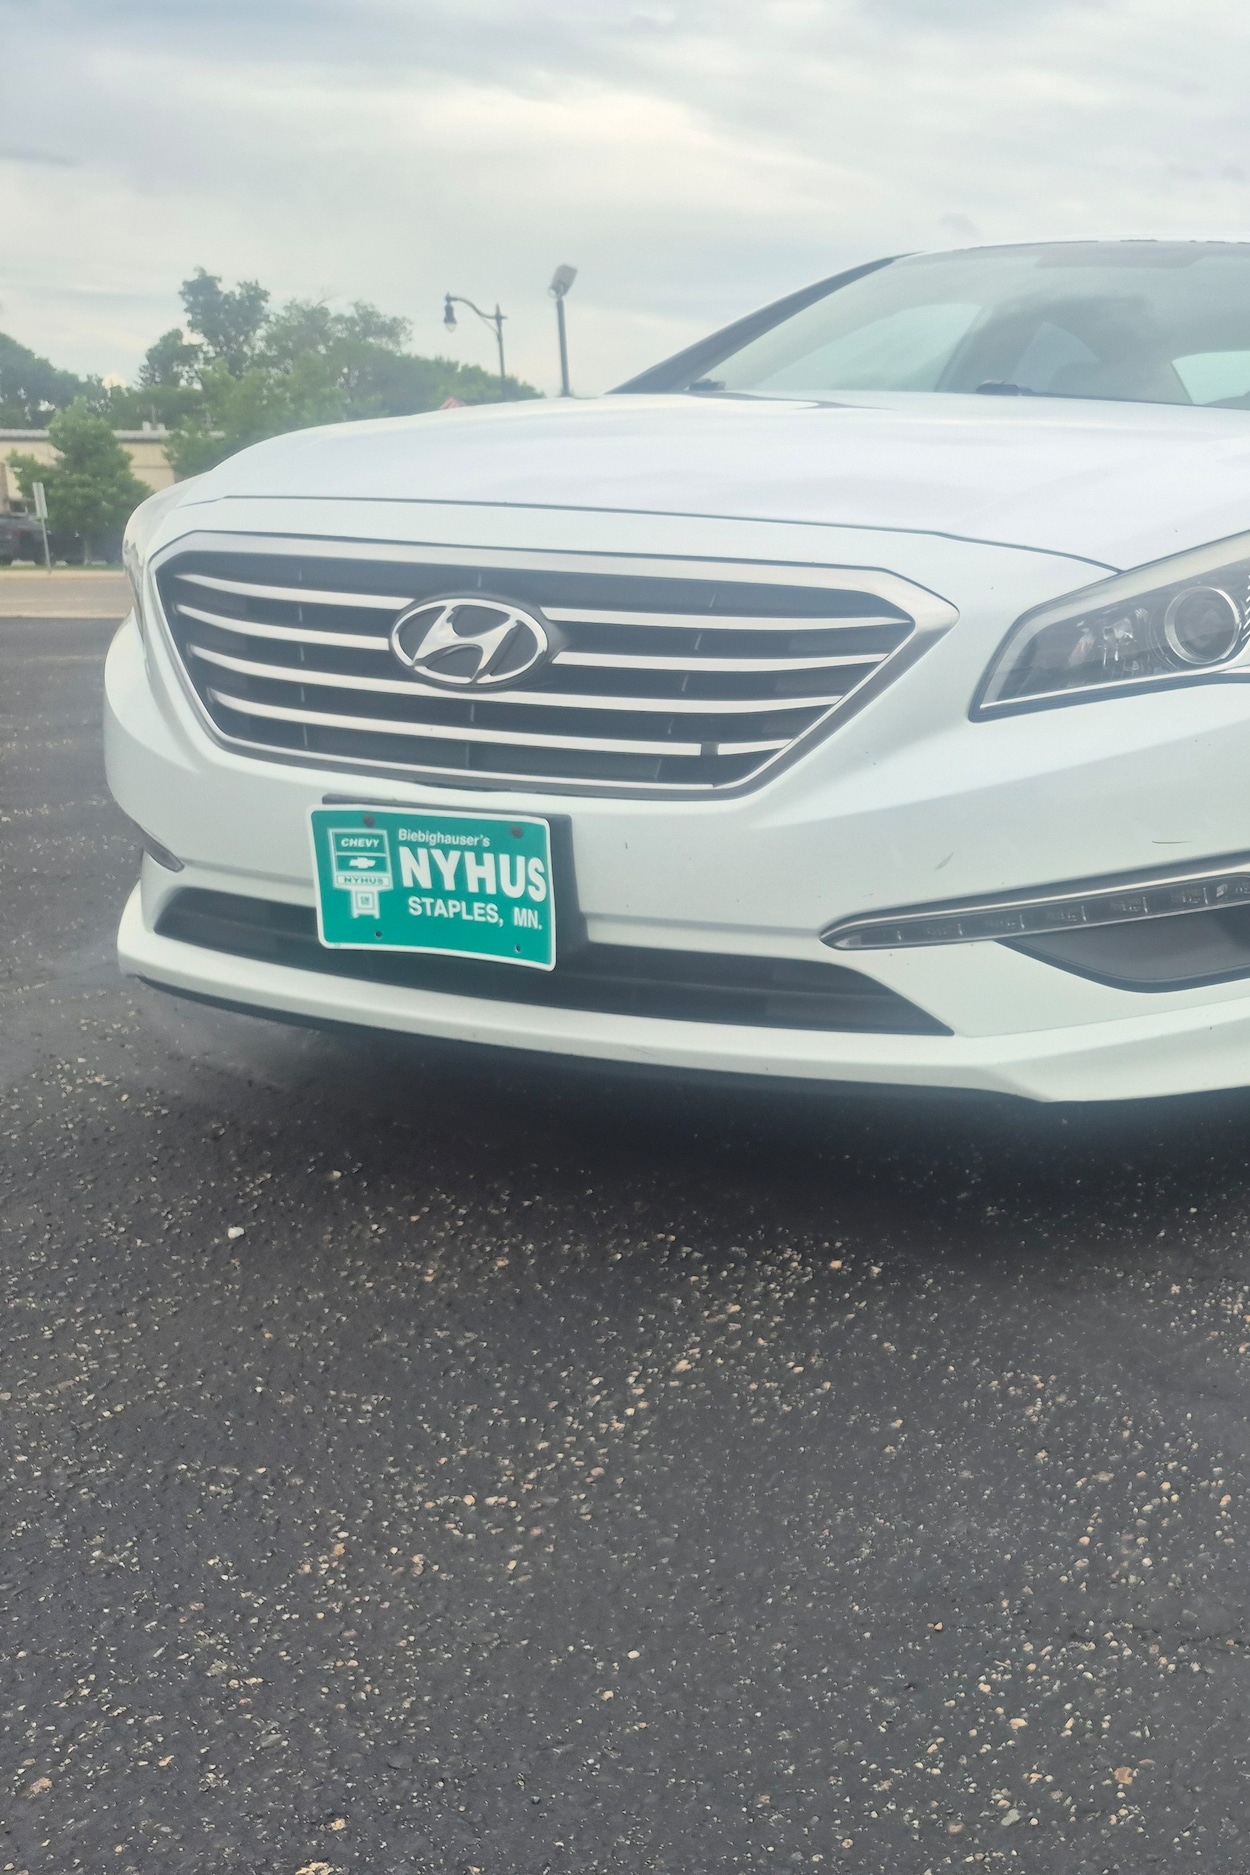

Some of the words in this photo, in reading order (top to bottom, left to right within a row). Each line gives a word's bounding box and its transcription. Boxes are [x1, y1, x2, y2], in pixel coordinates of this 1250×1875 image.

[341, 837, 379, 848] CHEVY
[398, 828, 490, 847] Biebighauser's
[343, 876, 384, 885] NYHUS
[399, 846, 547, 902] NYHUS
[408, 896, 504, 928] STAPLES,
[513, 907, 542, 930] MN.
